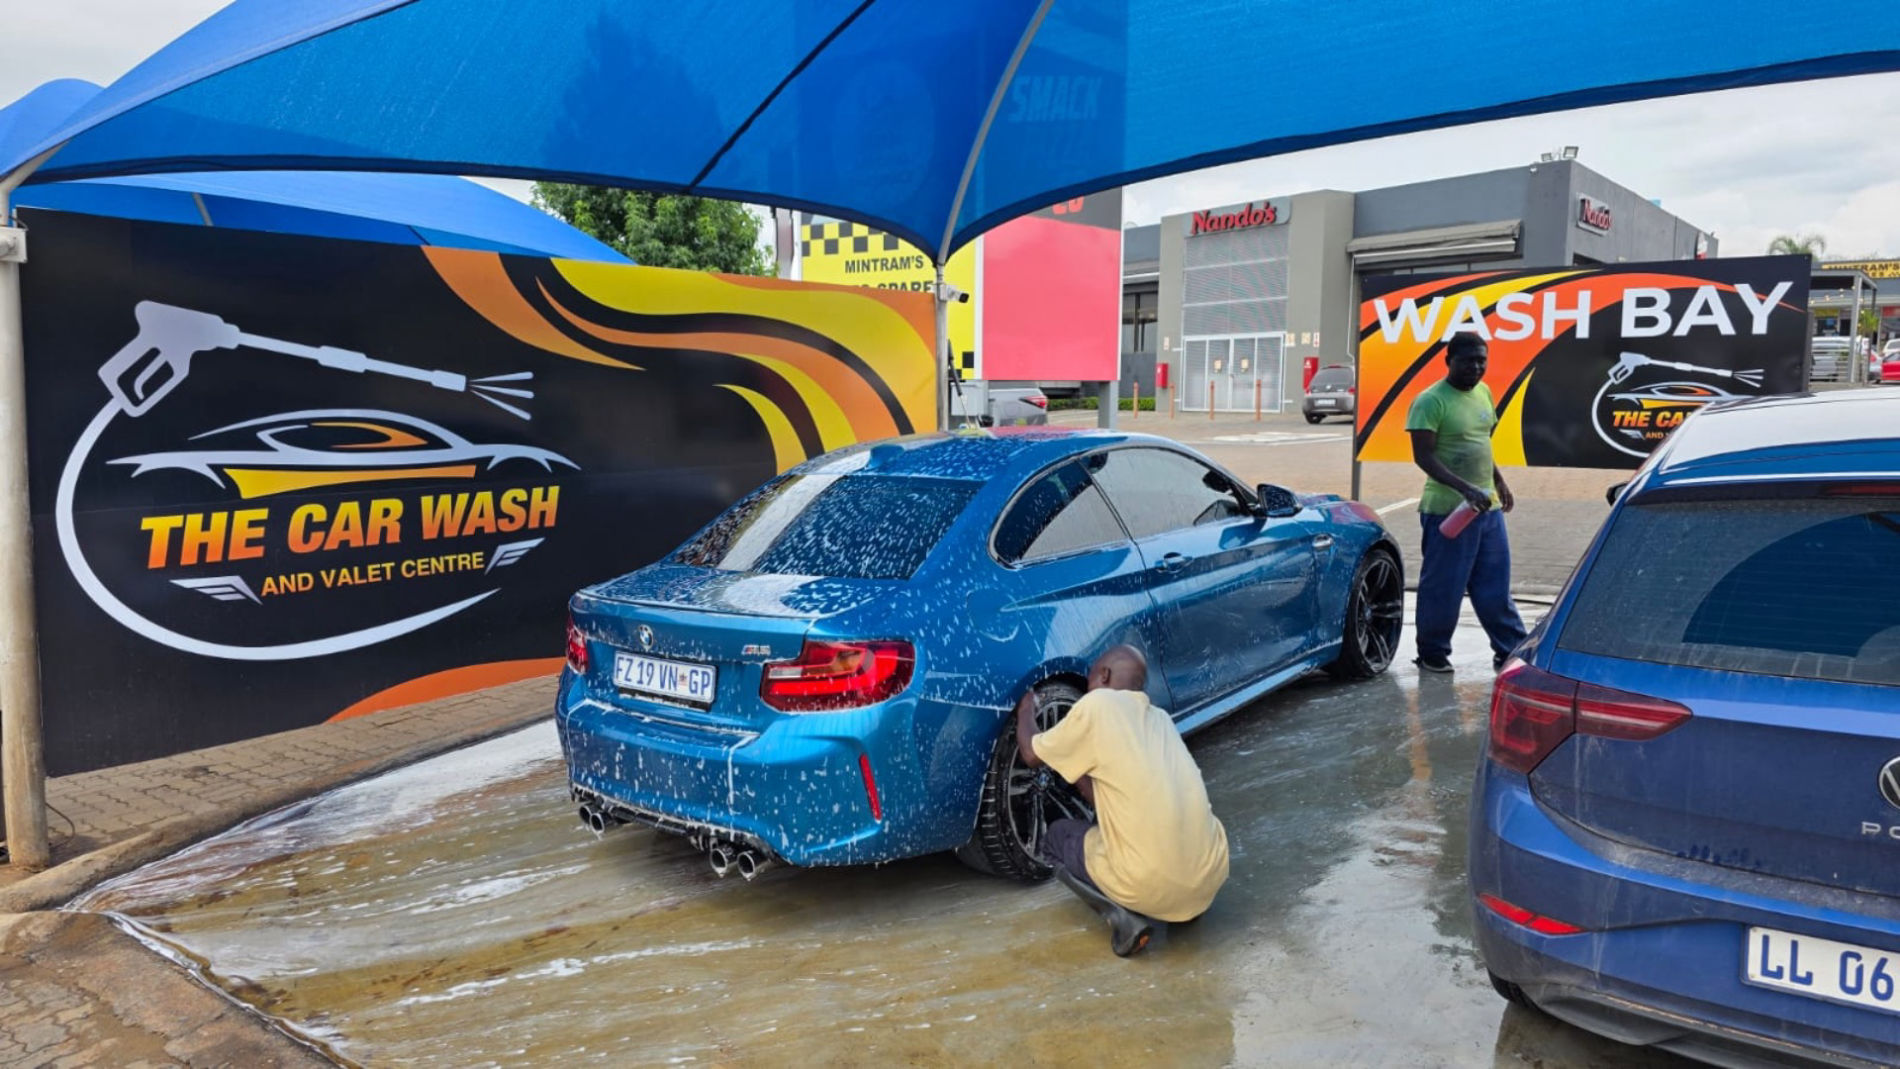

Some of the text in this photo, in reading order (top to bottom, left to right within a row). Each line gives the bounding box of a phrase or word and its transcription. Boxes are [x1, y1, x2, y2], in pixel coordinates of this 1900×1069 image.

[1007, 75, 1102, 123] SMACK
[1190, 200, 1277, 236] Nando's
[845, 255, 924, 273] MINTRAM'S
[1373, 281, 1794, 344] WASH BAY
[1612, 410, 1692, 428] THE CA
[1645, 431, 1664, 439] AND
[140, 485, 560, 569] THE CAR WASH
[261, 551, 485, 597] AND VALET CENTRE
[688, 669, 711, 696] GP
[1760, 934, 1894, 1001] LL 06
